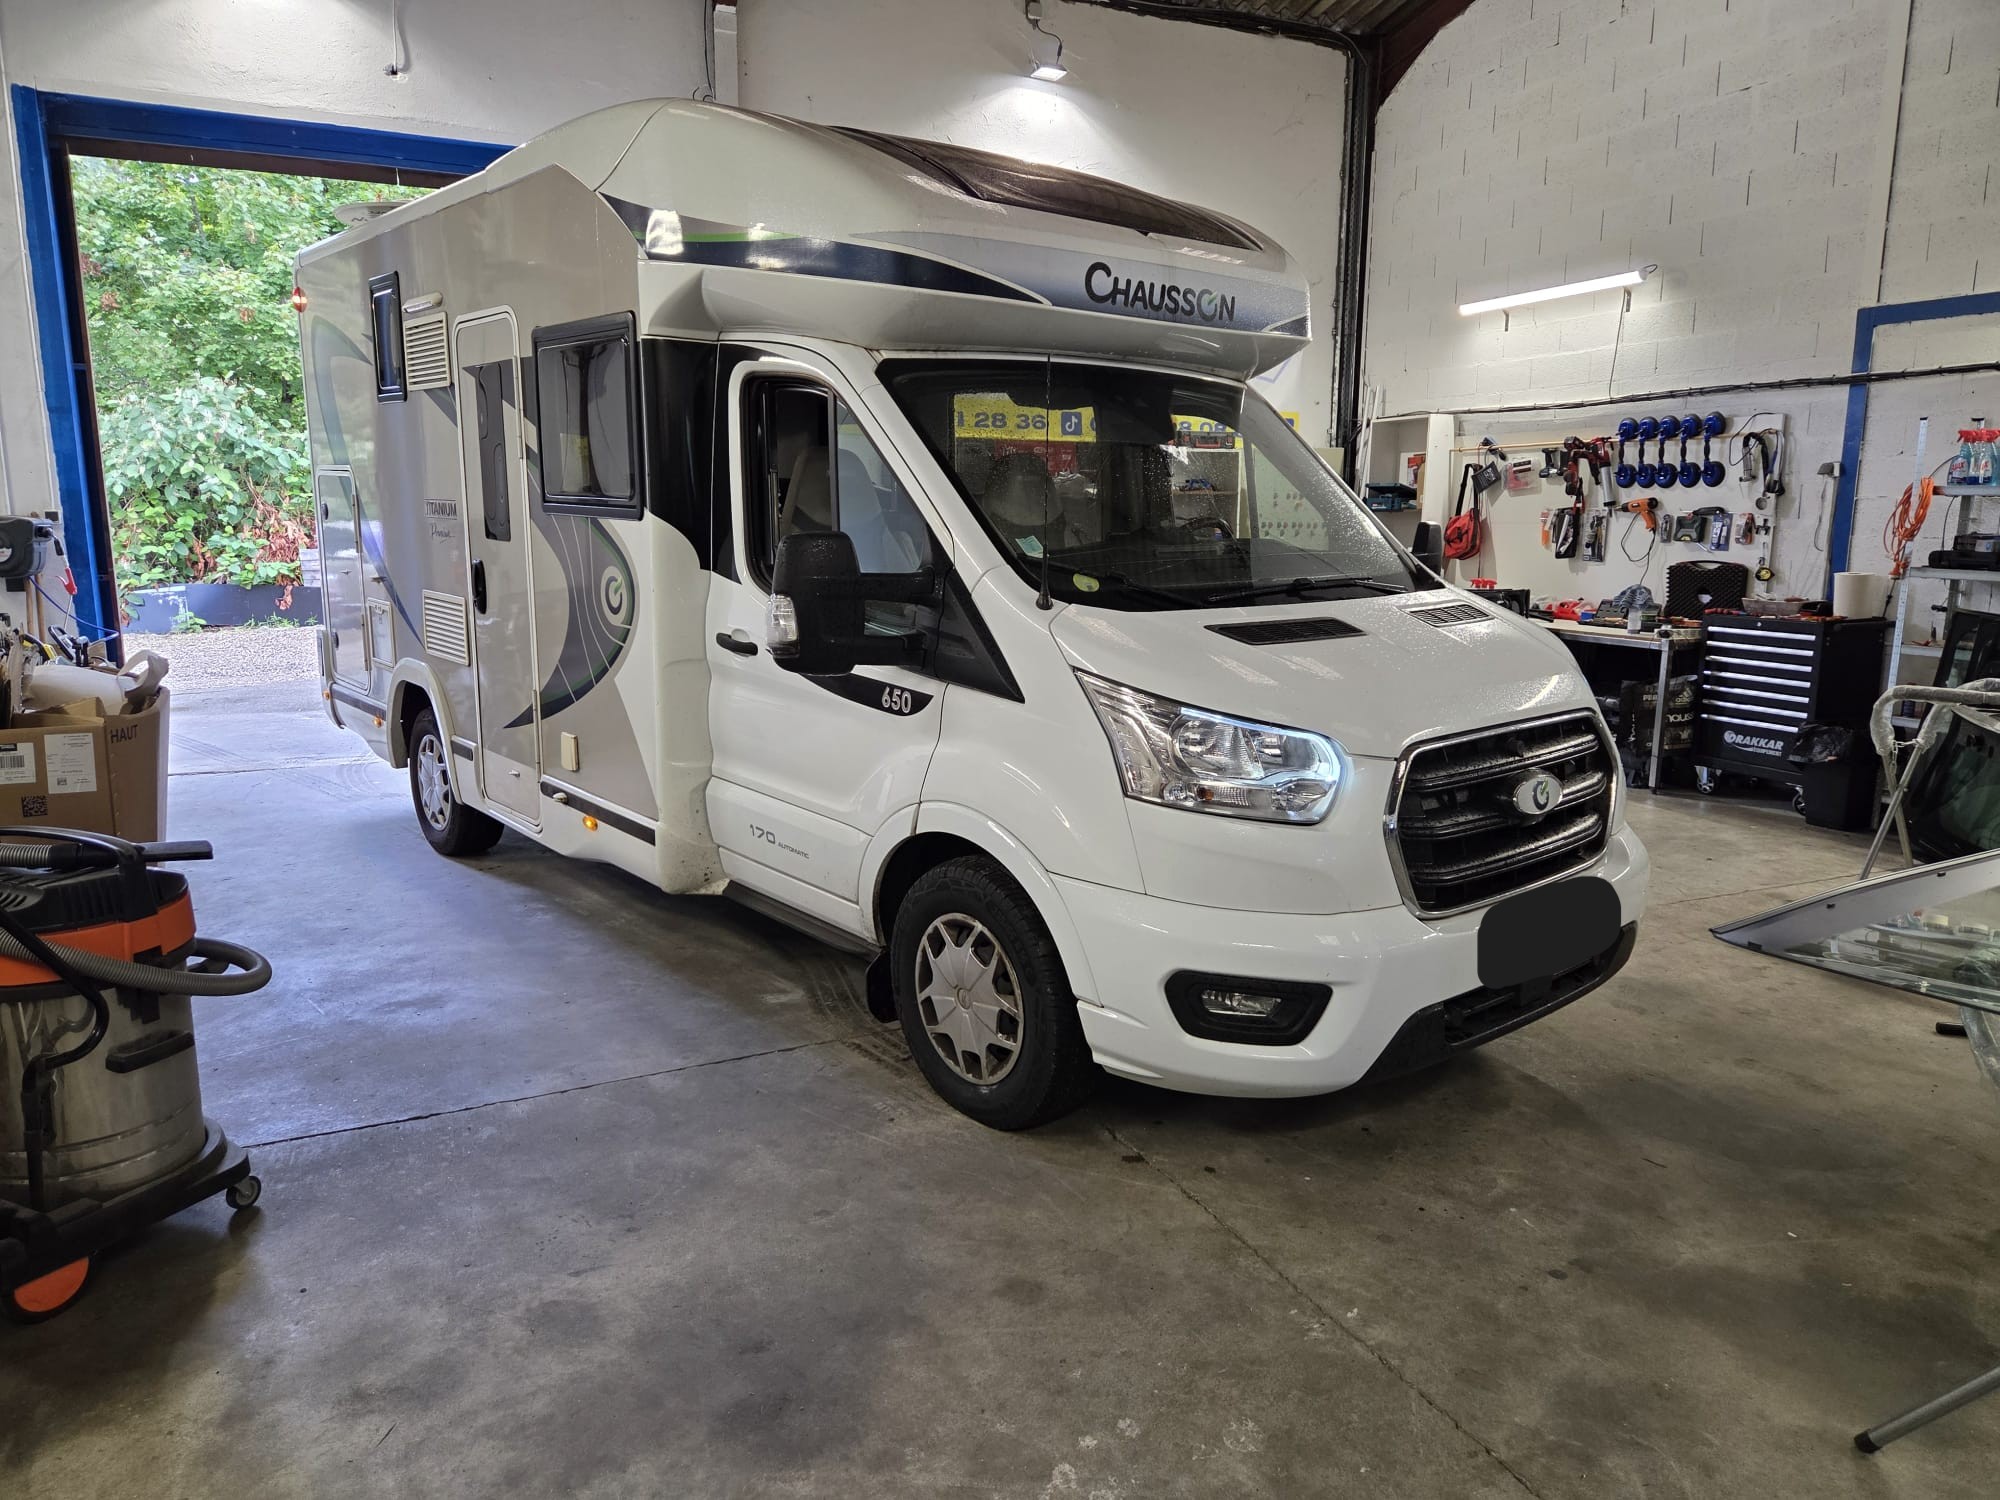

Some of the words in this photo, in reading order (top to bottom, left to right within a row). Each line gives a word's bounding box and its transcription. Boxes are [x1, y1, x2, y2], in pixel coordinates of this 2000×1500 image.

[1084, 260, 1237, 323] CHAUSSON
[973, 411, 1008, 429] 28
[1014, 413, 1048, 430] 36
[881, 686, 912, 714] 650
[110, 724, 138, 744] HAUT
[749, 823, 776, 845] 170
